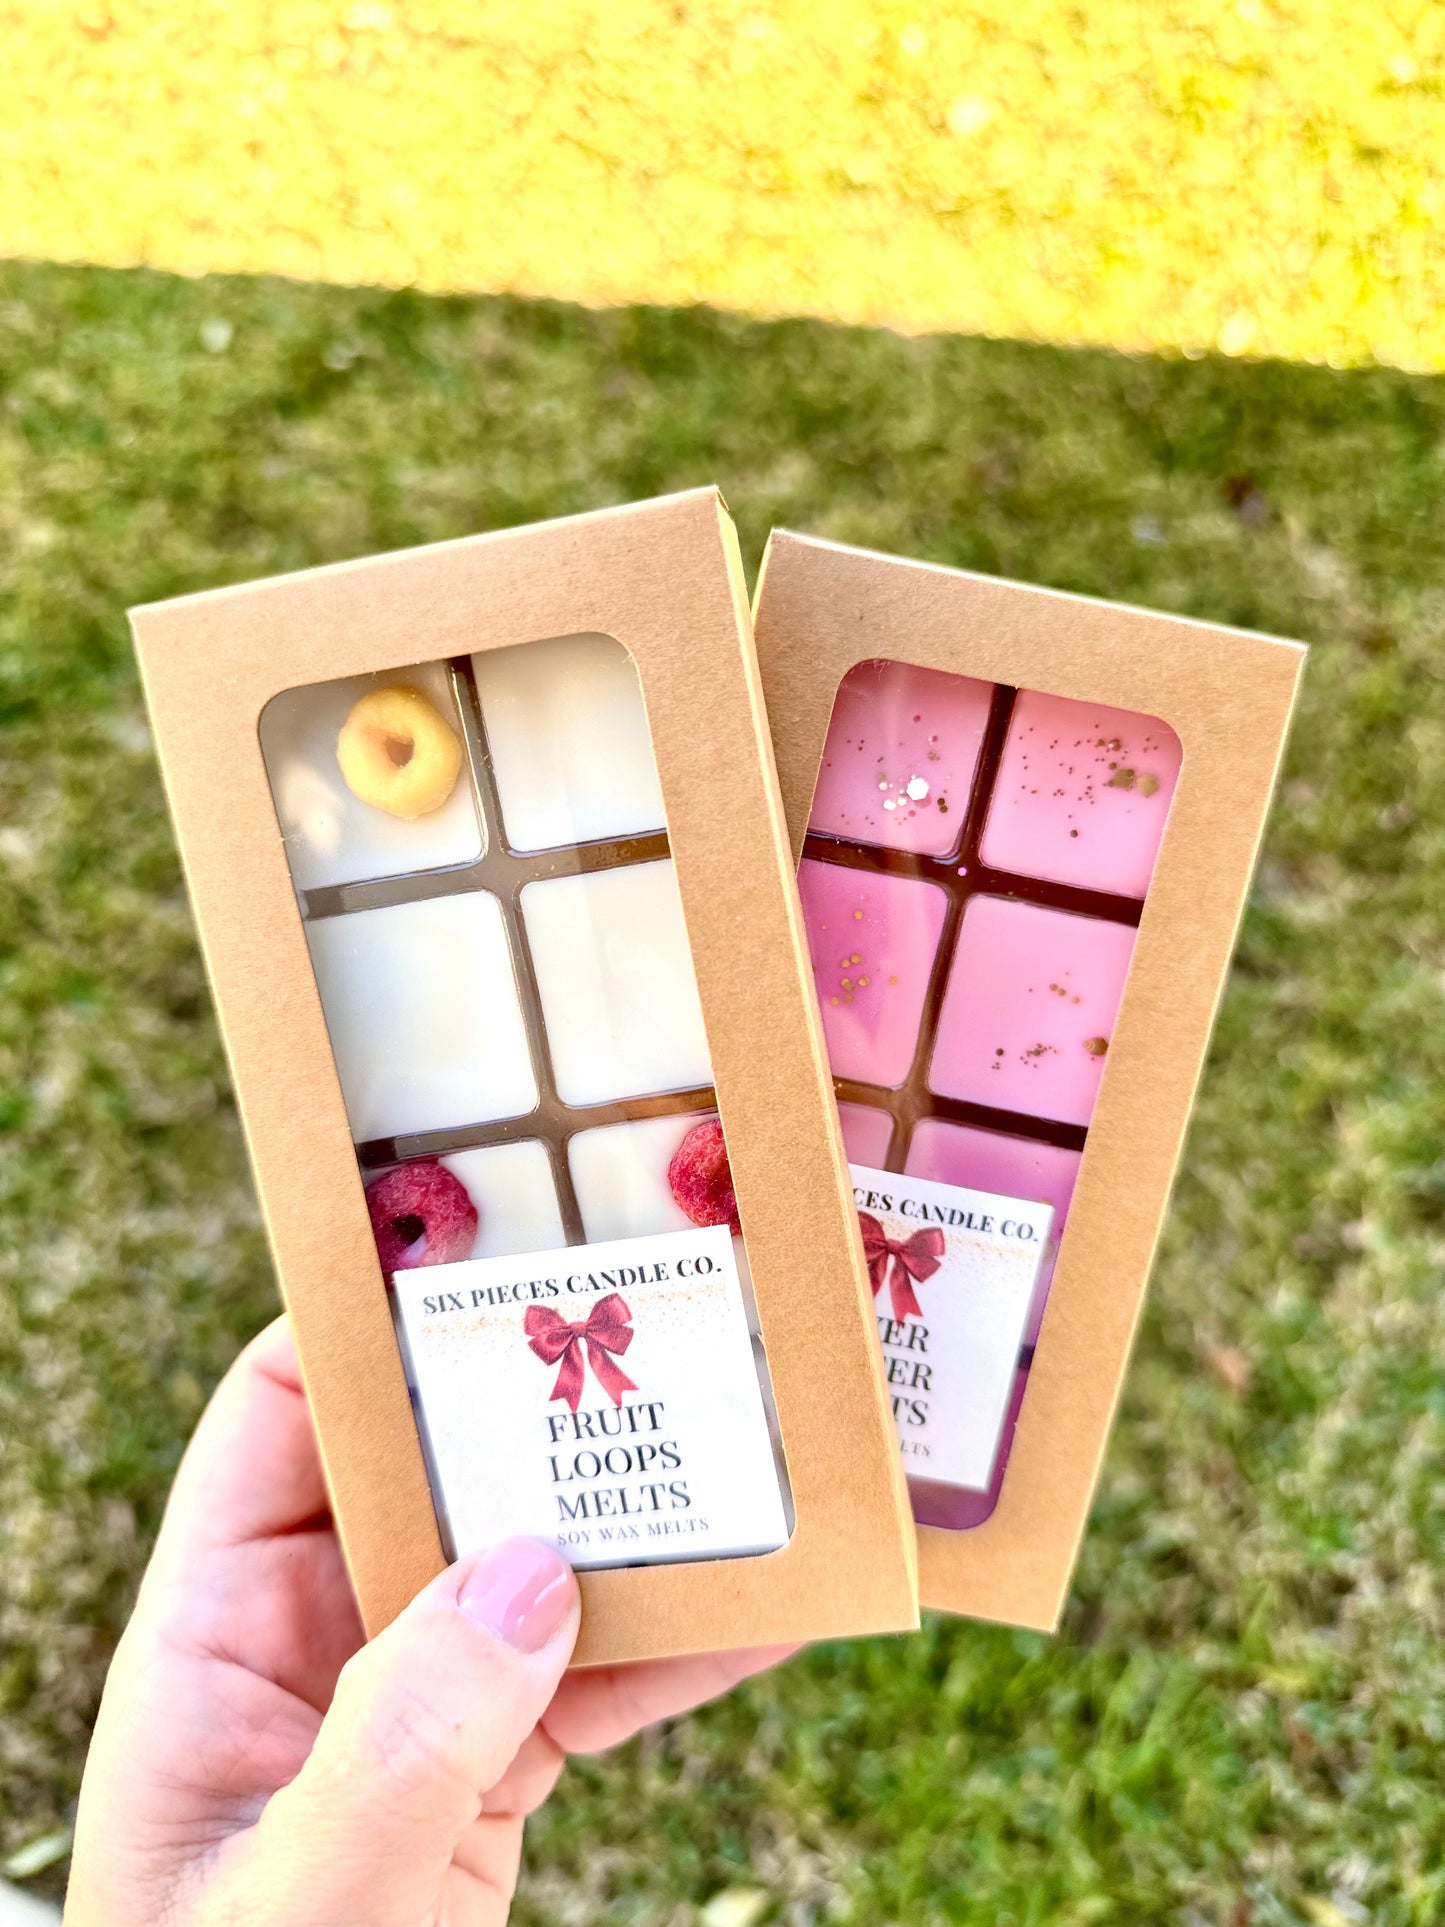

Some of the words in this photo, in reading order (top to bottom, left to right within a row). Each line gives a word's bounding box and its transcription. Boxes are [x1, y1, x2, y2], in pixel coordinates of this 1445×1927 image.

[899, 1198, 994, 1233] CANDLE
[1000, 1218, 1040, 1243] CO.
[423, 1291, 466, 1315] SIX
[471, 1278, 560, 1309] PIECES
[566, 1262, 671, 1295] CANDLE
[676, 1255, 723, 1278] CO.
[545, 1401, 665, 1443] FRUIT
[547, 1440, 683, 1483] LOOPS
[555, 1480, 692, 1522] MELTS
[556, 1529, 592, 1546] SOY
[598, 1523, 641, 1541] WAX
[646, 1517, 710, 1537] MELTS
